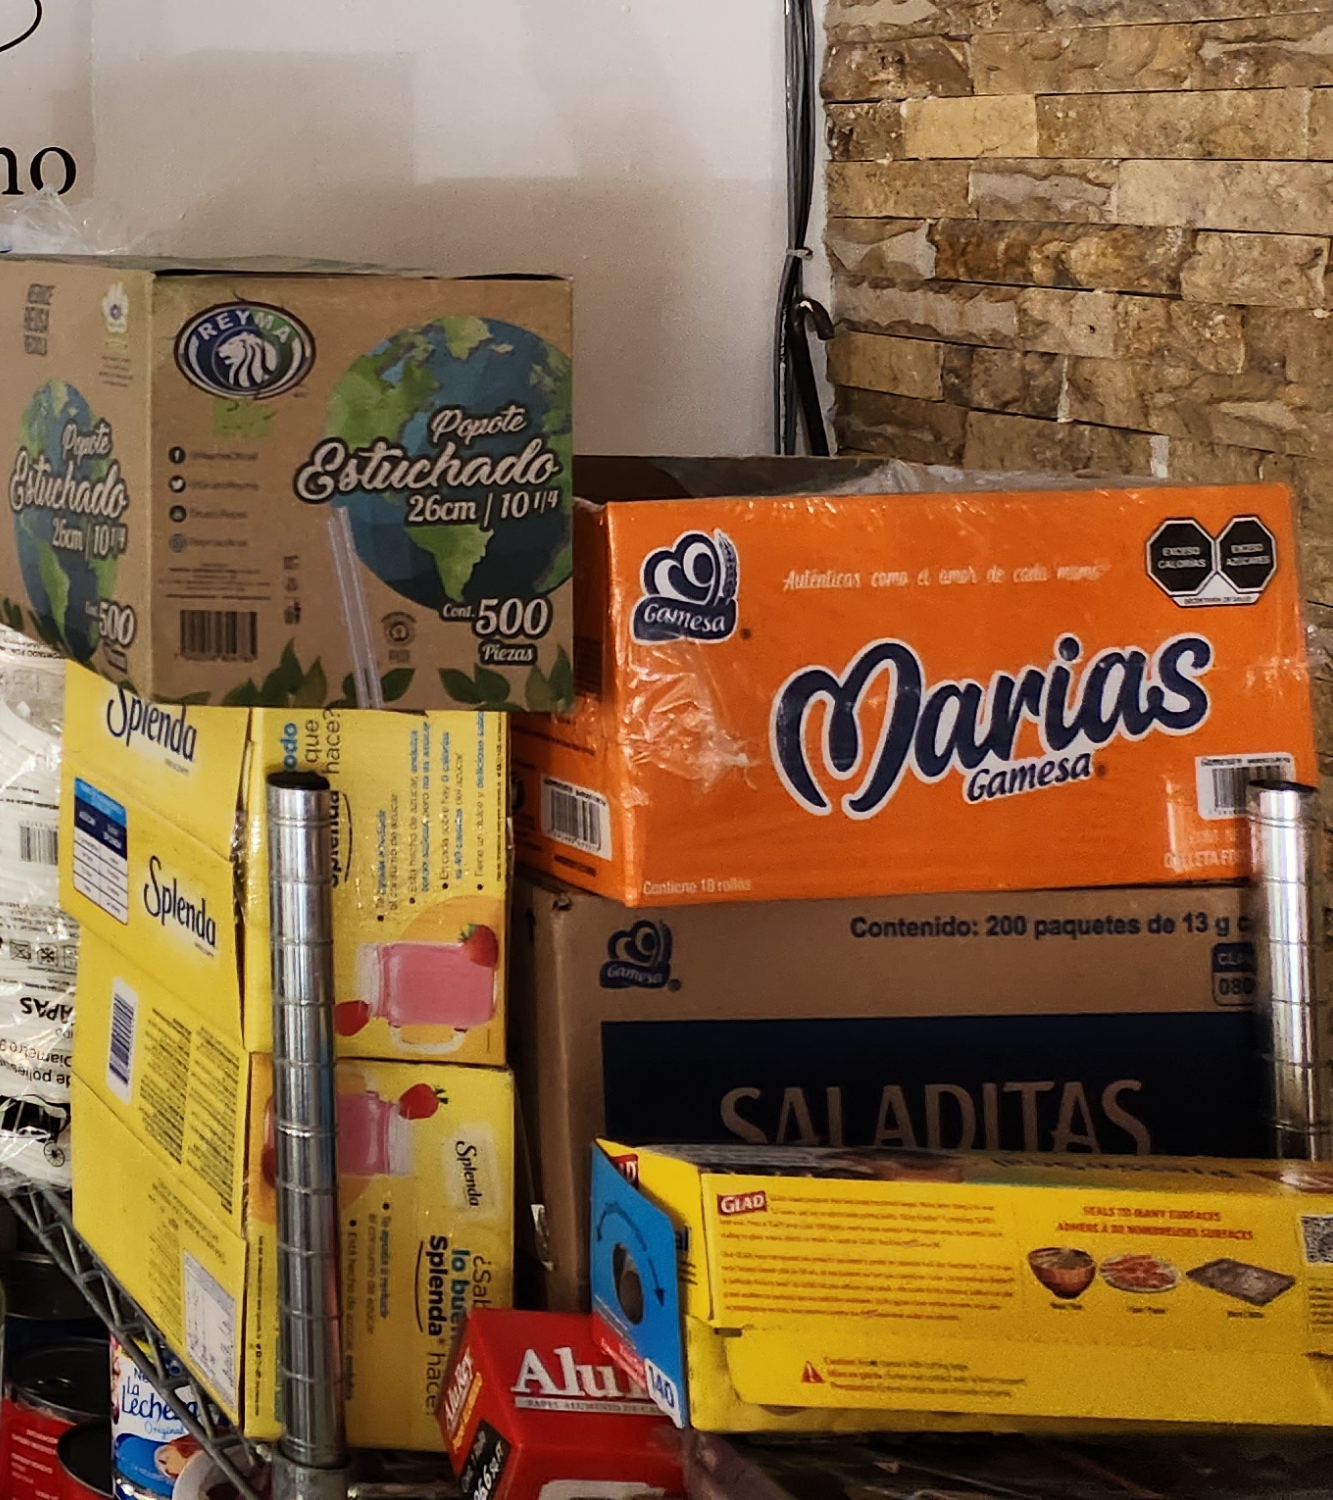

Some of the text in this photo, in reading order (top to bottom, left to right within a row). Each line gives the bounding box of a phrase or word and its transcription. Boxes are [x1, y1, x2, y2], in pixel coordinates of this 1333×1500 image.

[197, 309, 292, 344] REYMA
[62, 422, 111, 464] Popote
[432, 404, 527, 446] Popote
[10, 449, 128, 519] Estuchado
[297, 438, 559, 501] Estuchado
[408, 494, 477, 522] 26cm
[98, 602, 135, 646] 500
[475, 597, 549, 636] 500
[643, 601, 727, 633] Gamesa
[482, 643, 534, 662] Piezas
[280, 722, 298, 770] odo
[304, 720, 320, 763] que
[966, 752, 1093, 803] Gamesa
[143, 854, 217, 948] Splenda
[850, 915, 979, 939] Contenido:
[986, 914, 1027, 937] 200
[1033, 914, 1141, 941] paquetes
[1147, 914, 1175, 935] de
[1182, 912, 1209, 933] 13
[19, 996, 74, 1024] APAS
[720, 1079, 1152, 1155] SALADITAS
[454, 1140, 483, 1208] Splenda
[720, 1193, 766, 1214] GLAD
[452, 1249, 470, 1272] lo
[471, 1255, 491, 1309] ¿Sab
[126, 1375, 140, 1398] La
[510, 1346, 649, 1400] Alu
[121, 1384, 199, 1423] Lechea
